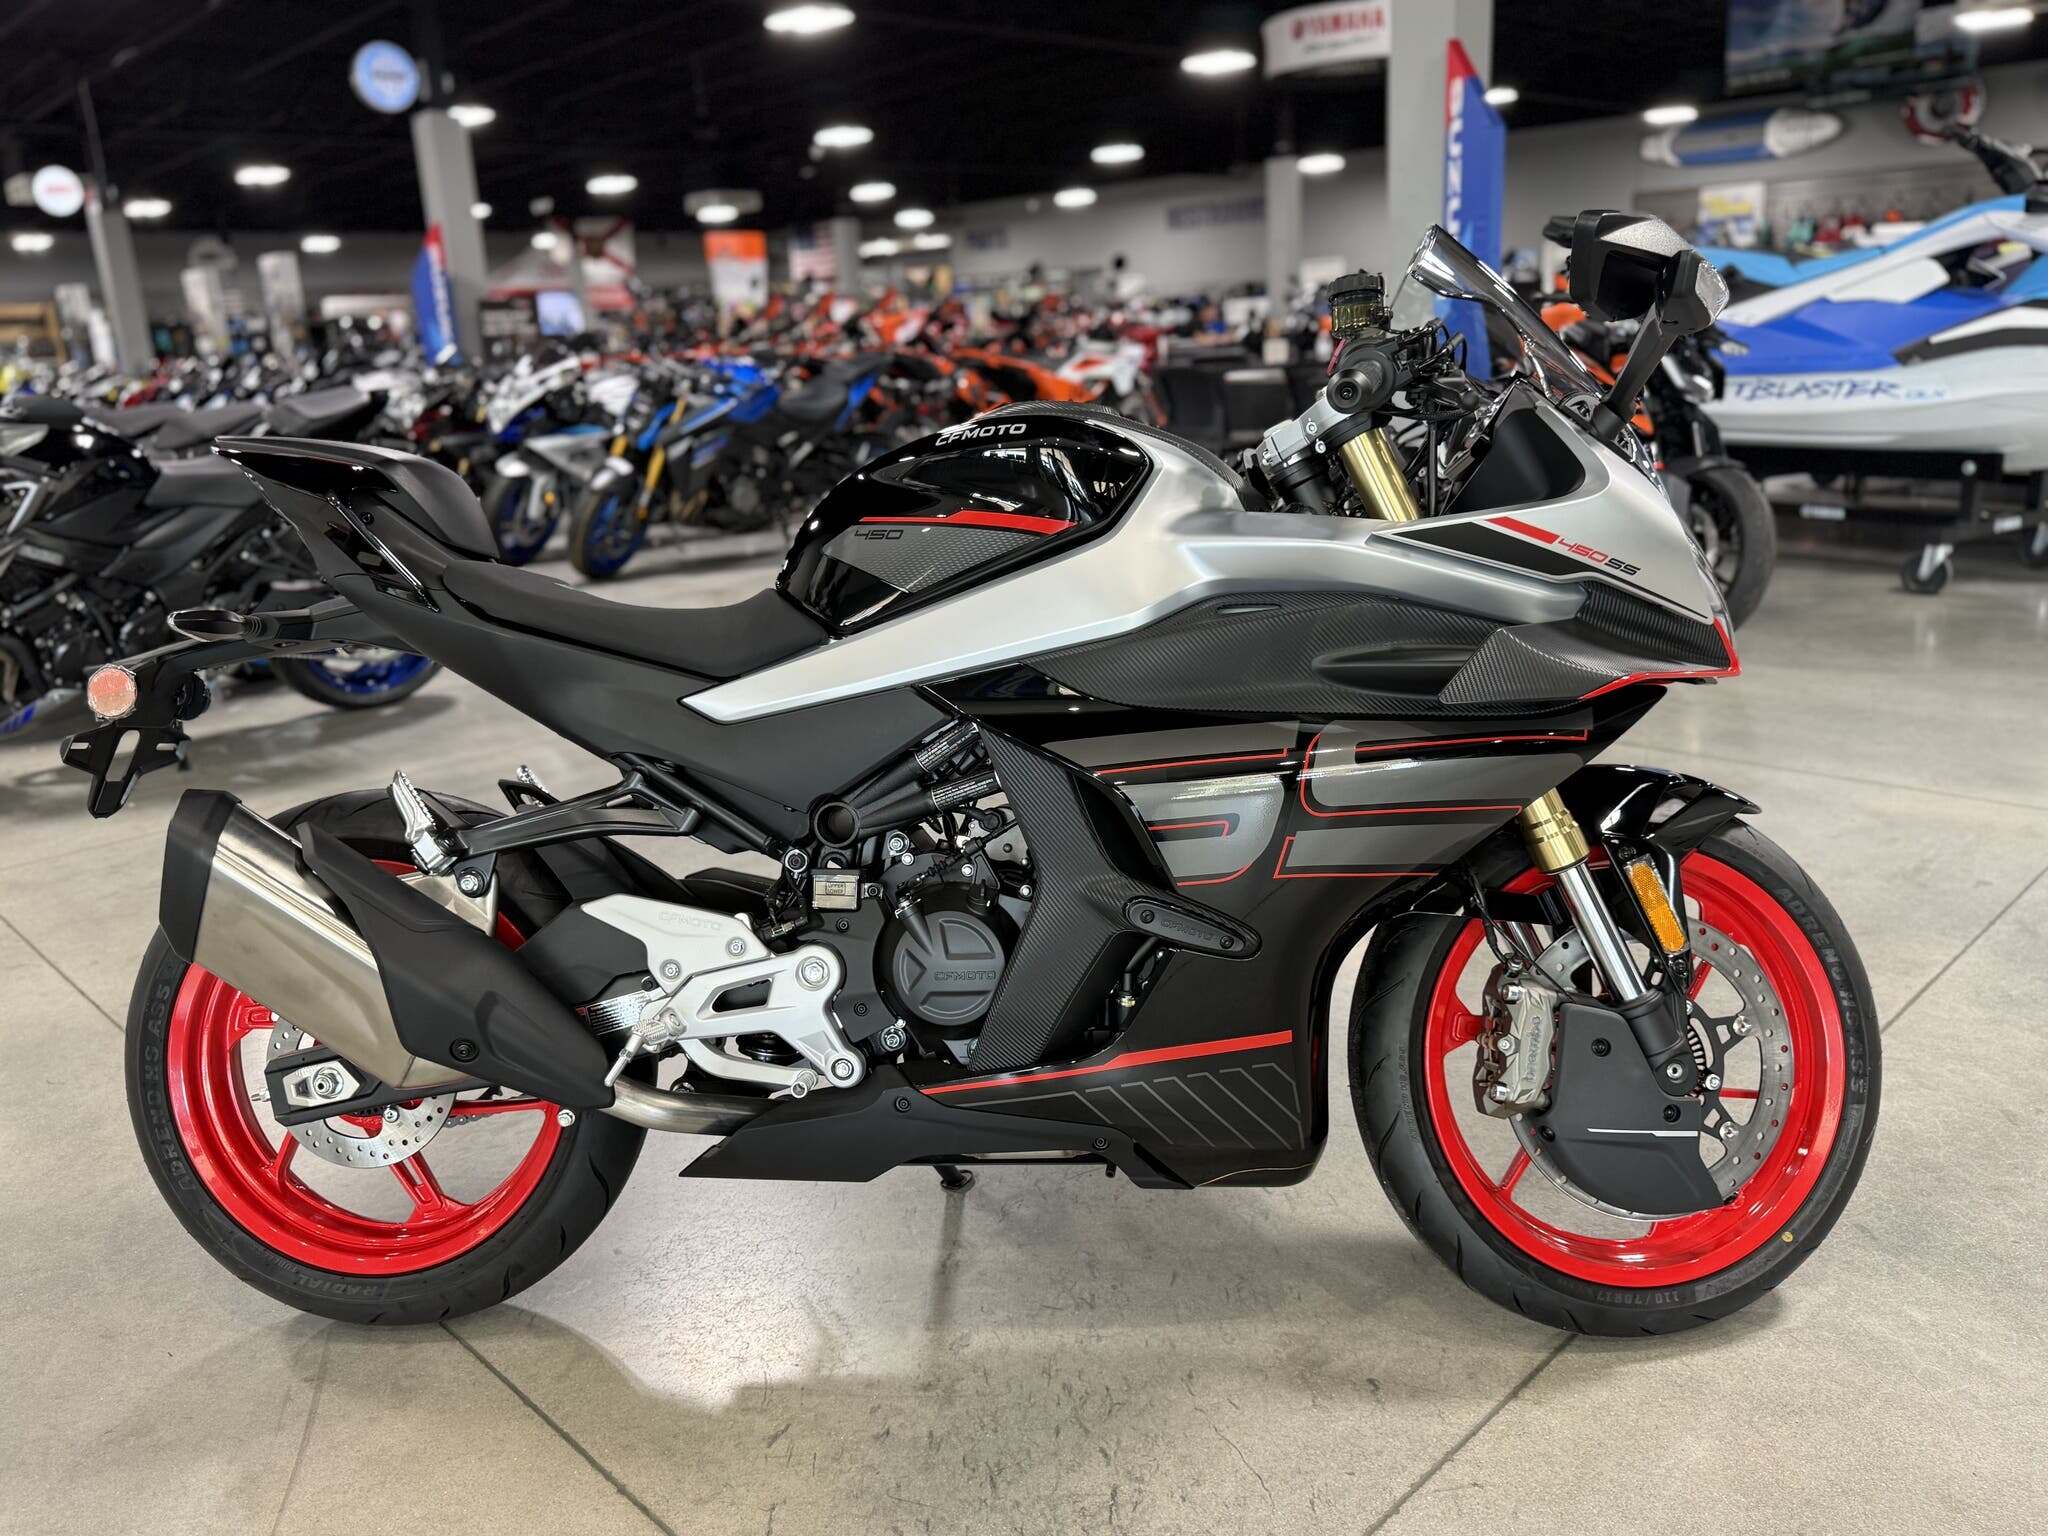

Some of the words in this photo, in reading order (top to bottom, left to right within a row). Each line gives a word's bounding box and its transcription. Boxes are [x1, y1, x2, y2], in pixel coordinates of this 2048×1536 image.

[1446, 76, 1463, 241] SUZU
[935, 423, 1027, 446] CFMOTO
[854, 529, 904, 540] 450
[934, 970, 997, 981] CFMOTO
